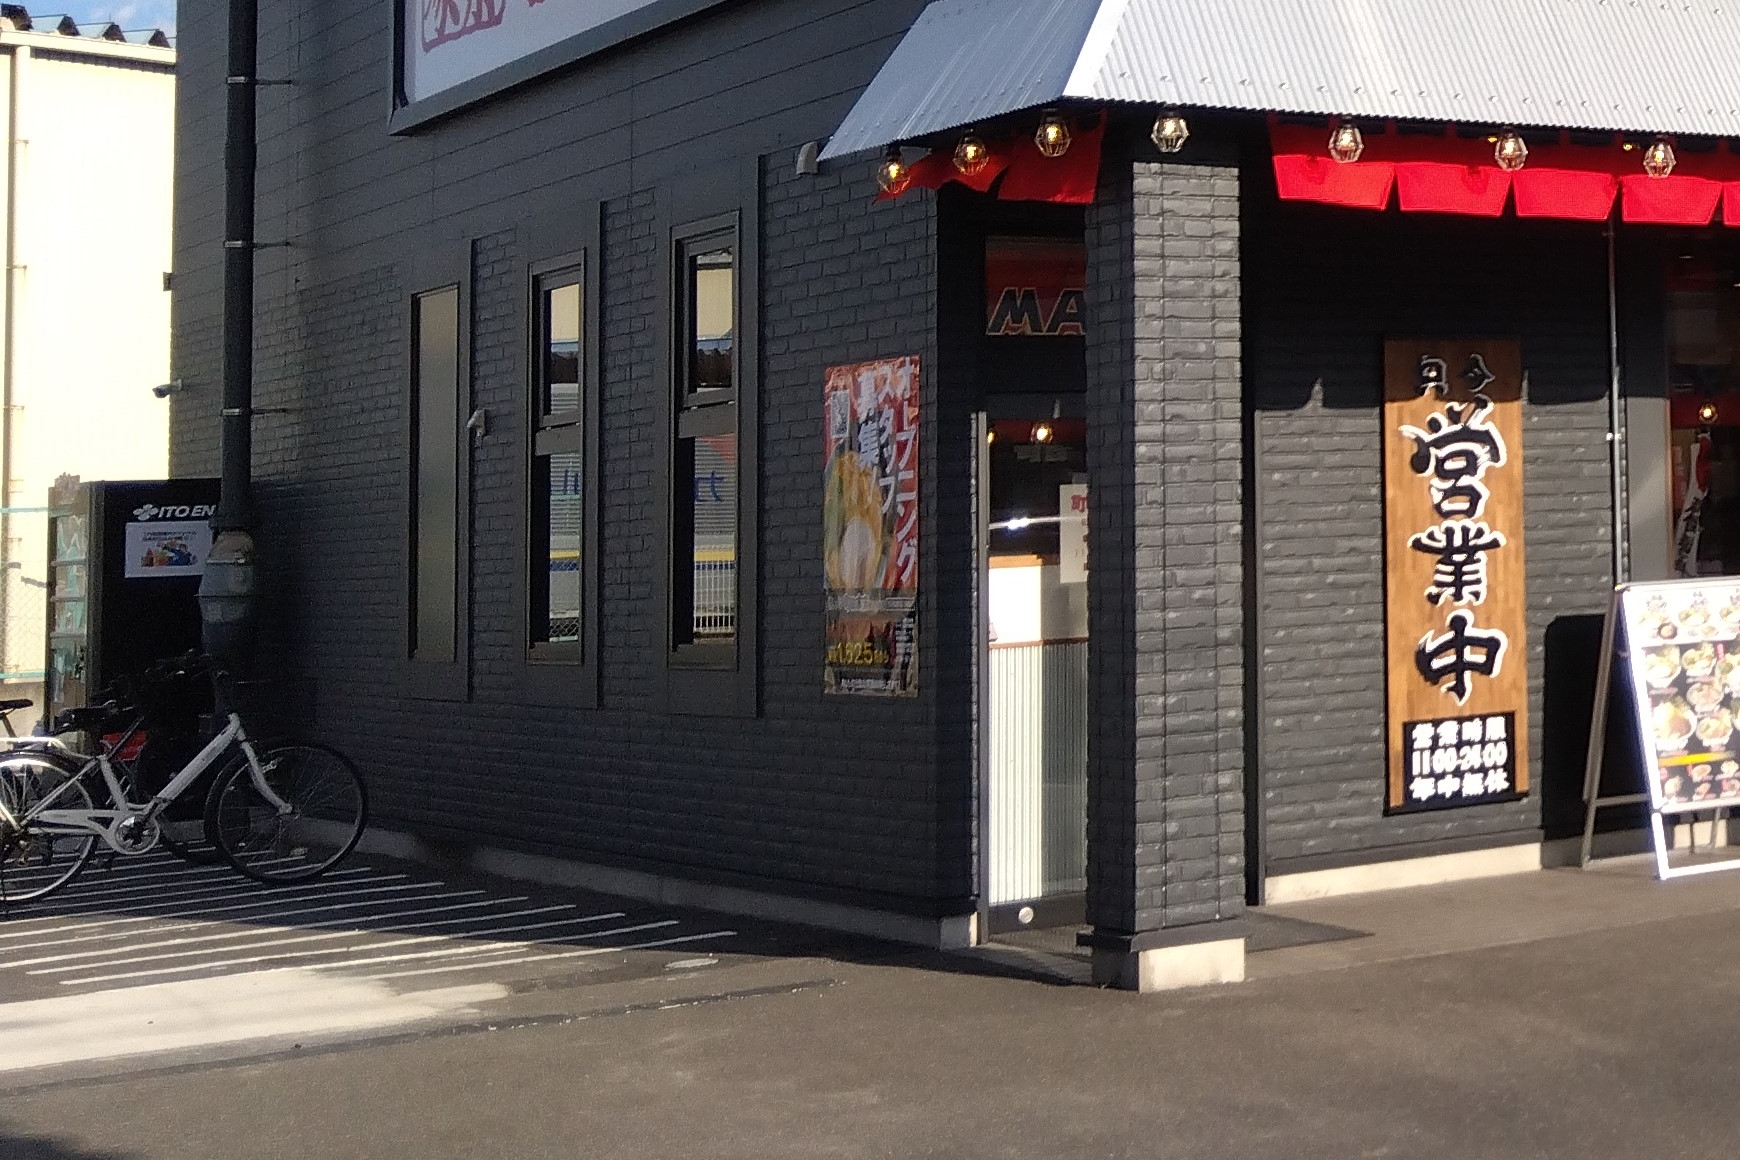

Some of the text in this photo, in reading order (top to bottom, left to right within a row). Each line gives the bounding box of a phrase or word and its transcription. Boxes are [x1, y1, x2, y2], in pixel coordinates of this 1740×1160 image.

[158, 504, 217, 518] ITO EN
[1400, 394, 1507, 706] 営業中
